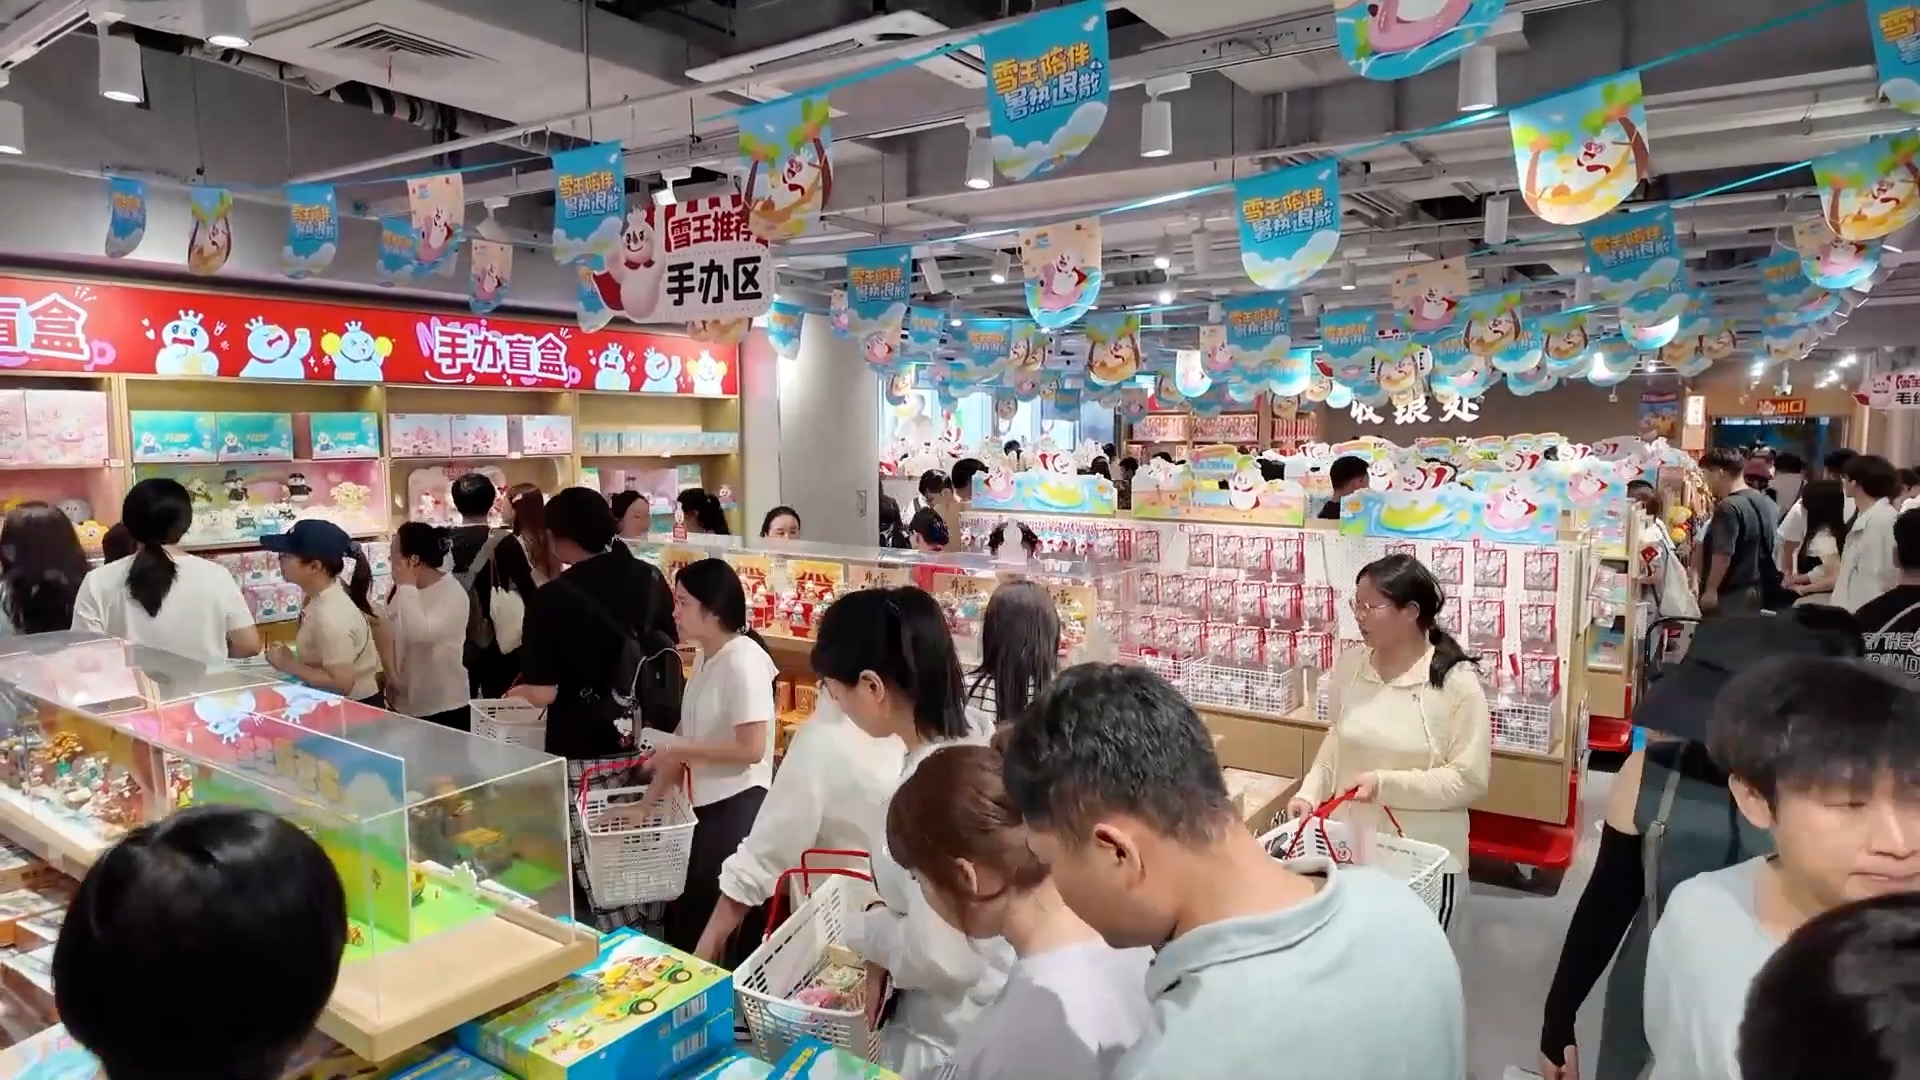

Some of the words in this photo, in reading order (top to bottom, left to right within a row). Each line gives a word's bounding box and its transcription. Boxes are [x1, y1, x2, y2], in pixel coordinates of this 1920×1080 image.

[993, 43, 1091, 94] 雪王陪伴
[1004, 68, 1102, 120] 暑热退散
[559, 171, 614, 199] 雪王陪伴
[1243, 187, 1323, 224] 雪王陪伴
[671, 211, 753, 250] 雪王推荐
[1253, 206, 1333, 243] 暑热退散
[667, 256, 762, 306] 手办区
[434, 325, 568, 381] 手办盲盒
